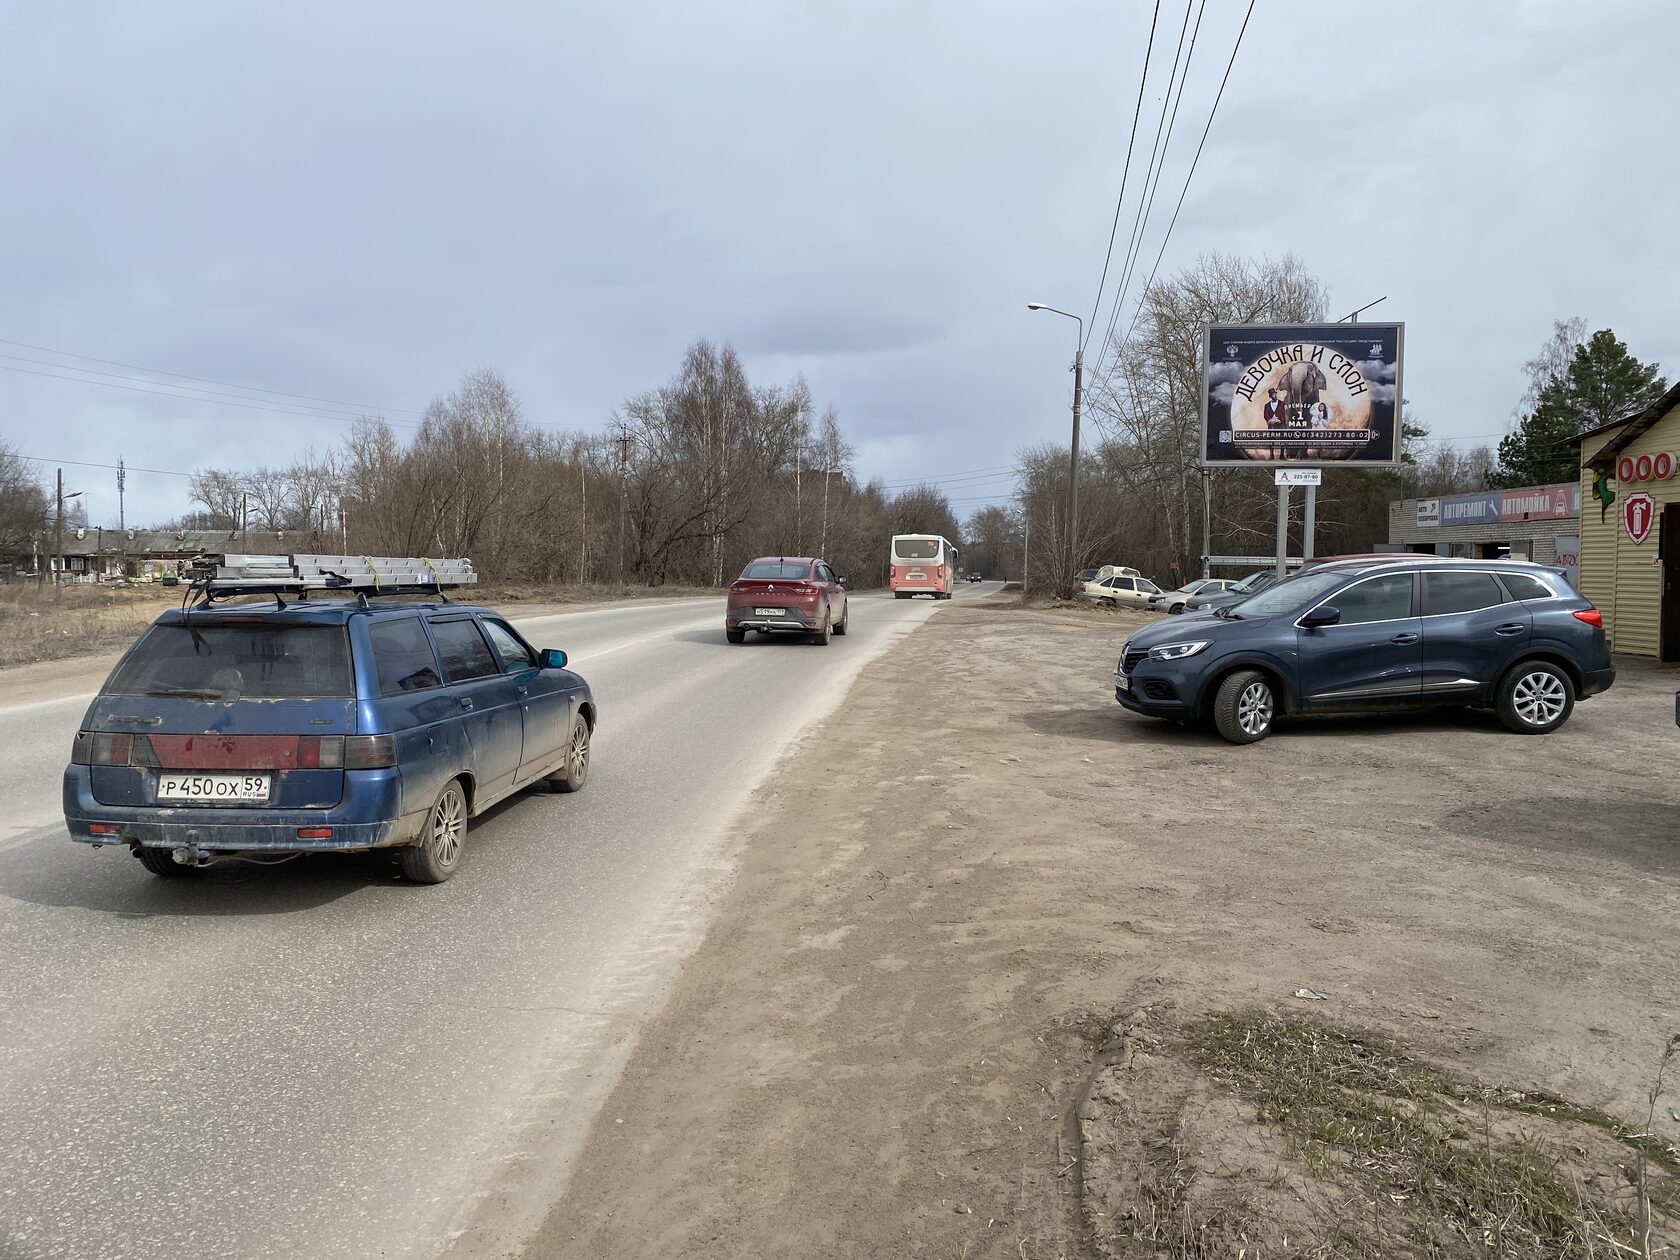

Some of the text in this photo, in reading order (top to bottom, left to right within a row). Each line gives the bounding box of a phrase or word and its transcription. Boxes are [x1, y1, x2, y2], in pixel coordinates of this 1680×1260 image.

[1235, 345, 1368, 402] ДЕВОЧКА И СЛОН
[1297, 411, 1304, 420] 1
[1618, 452, 1672, 483] ООО
[1443, 501, 1487, 519] АВТОРЕМОНТ
[1502, 493, 1550, 515] АВТОМОЙКА
[244, 778, 263, 791] 59
